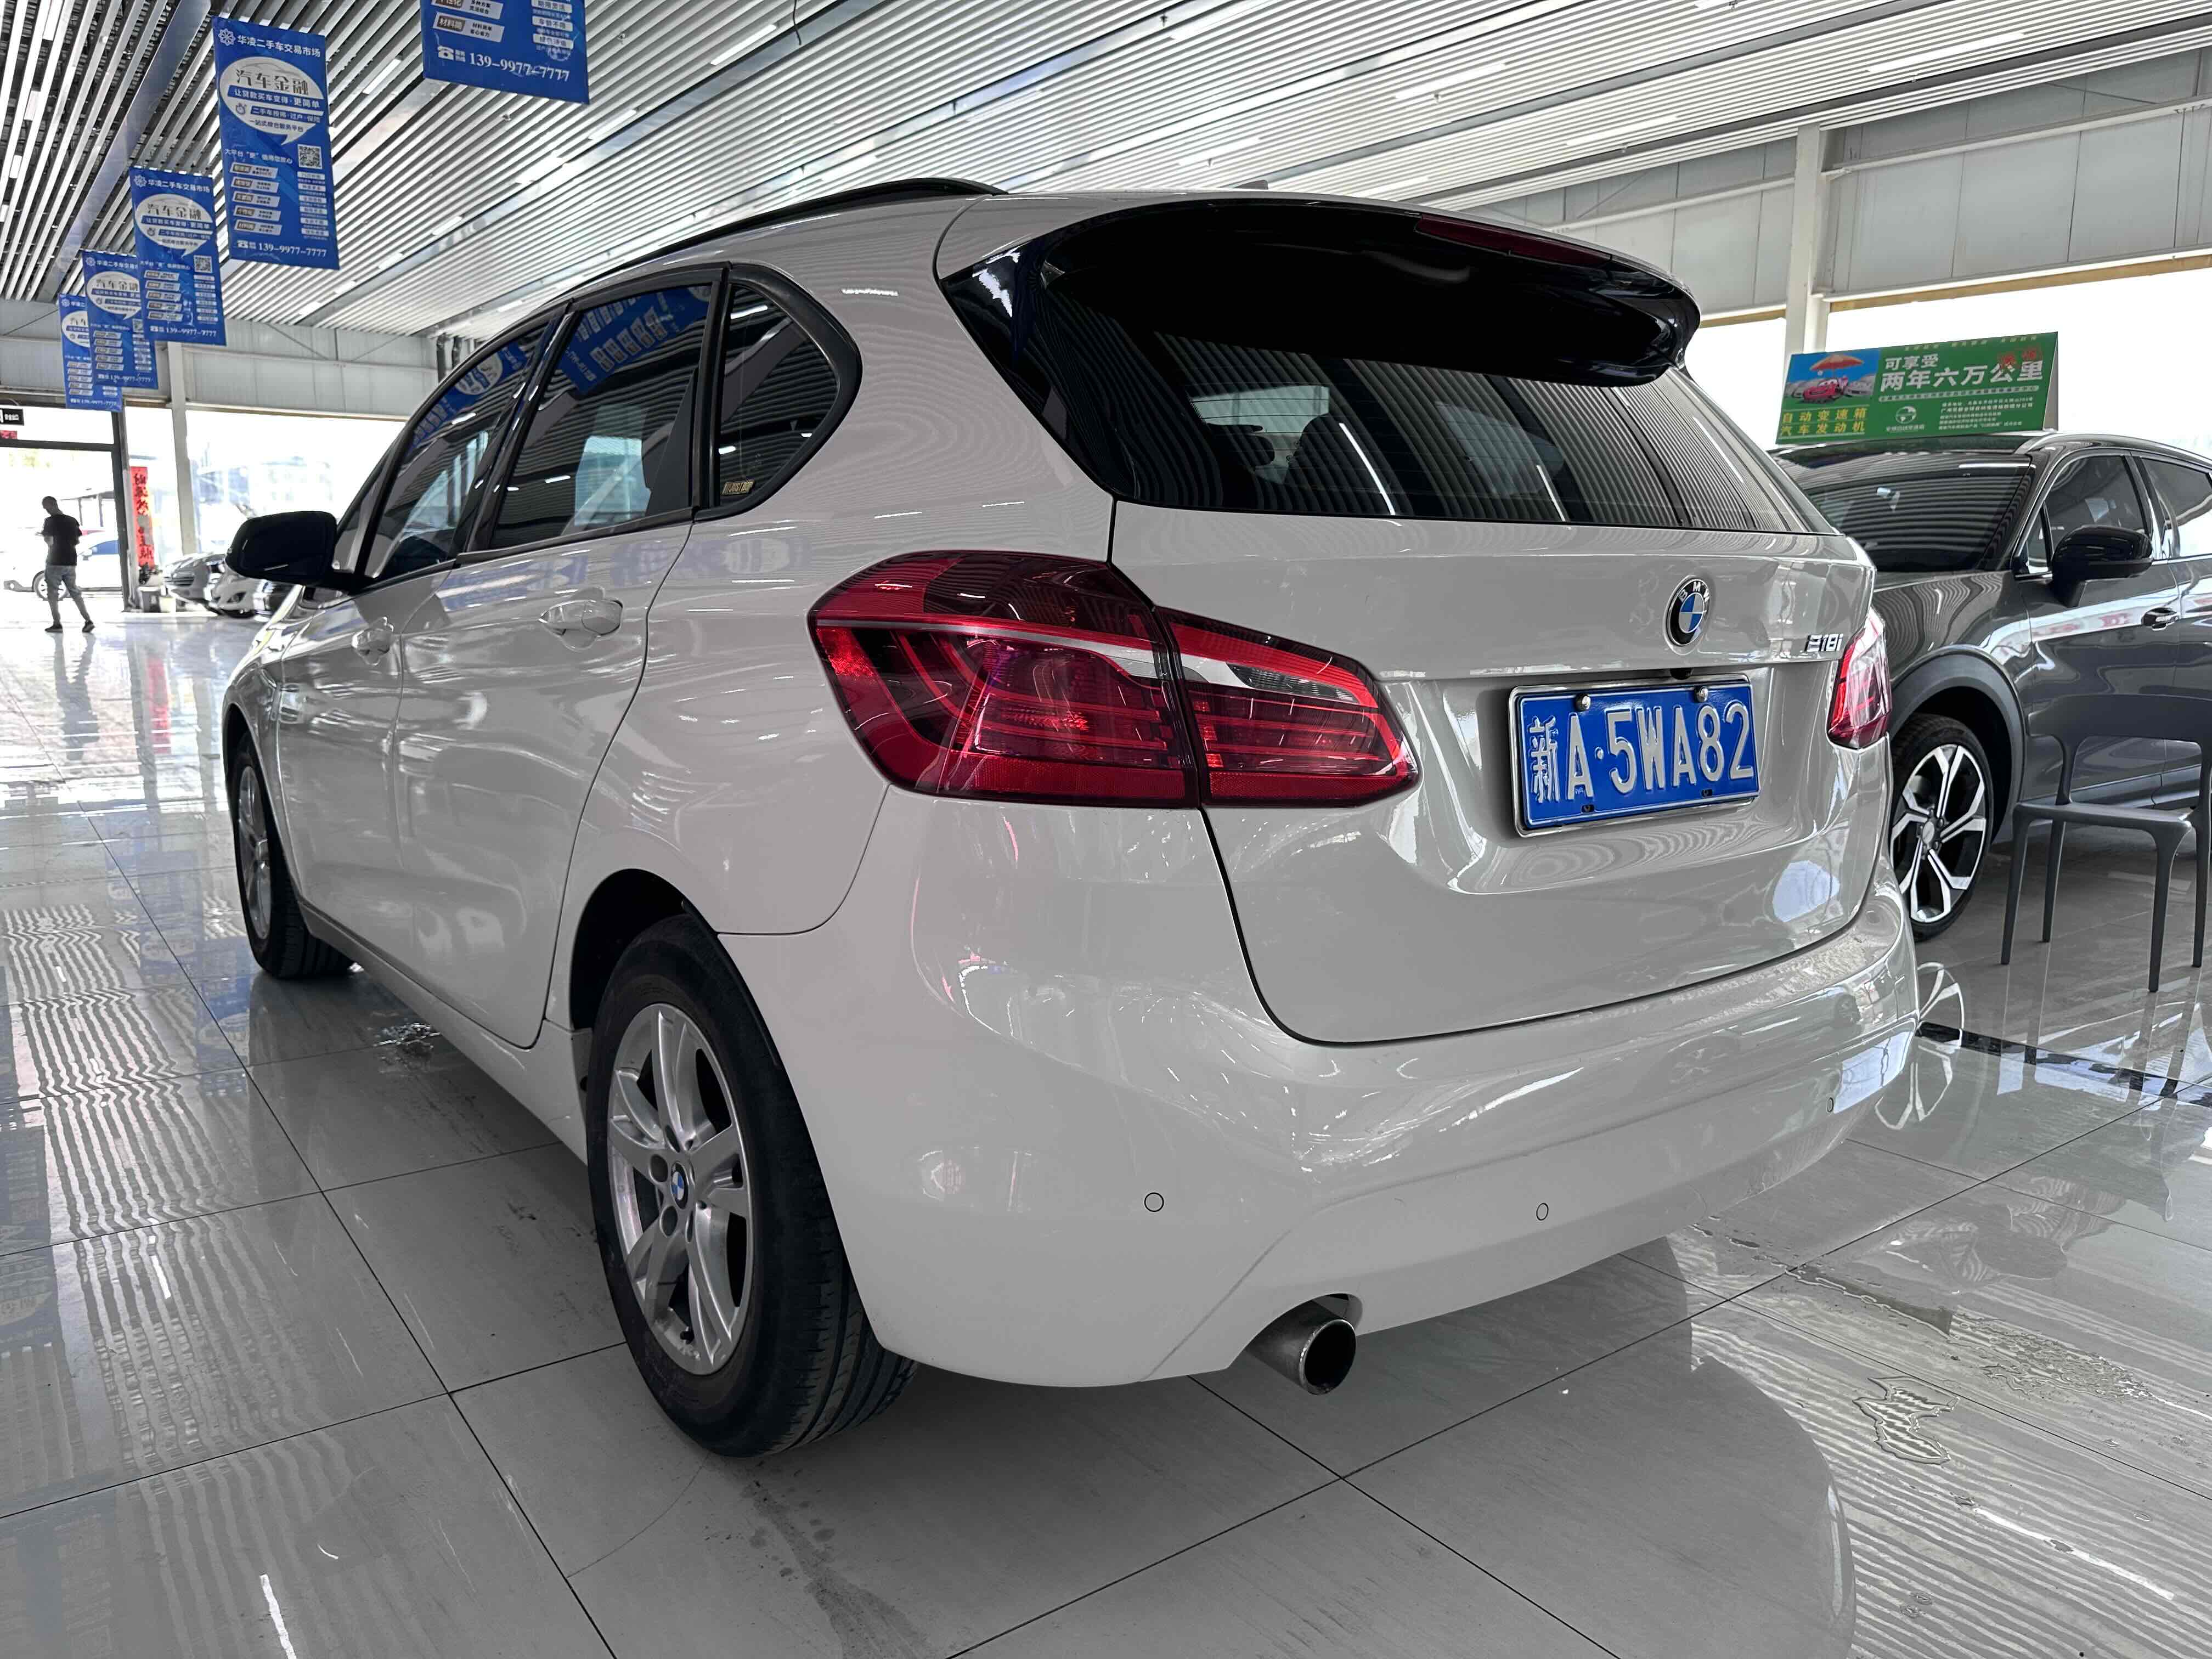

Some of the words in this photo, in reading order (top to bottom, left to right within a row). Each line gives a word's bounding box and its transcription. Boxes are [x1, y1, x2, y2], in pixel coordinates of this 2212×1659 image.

[237, 35, 321, 58] 华凌二手车交易市场
[470, 53, 570, 82] 139-9977-7777
[235, 69, 309, 95] 汽车金融
[148, 203, 202, 221] 汽车金融
[258, 242, 327, 257] 139-9977-7777
[1884, 353, 1939, 370] 可享受
[1880, 359, 2043, 392] 两年六万公里
[1782, 408, 1867, 424] 自动变速箱
[1781, 421, 1866, 436] 汽车发动机
[1678, 581, 1710, 603] BMW
[1806, 633, 1844, 652] 218i
